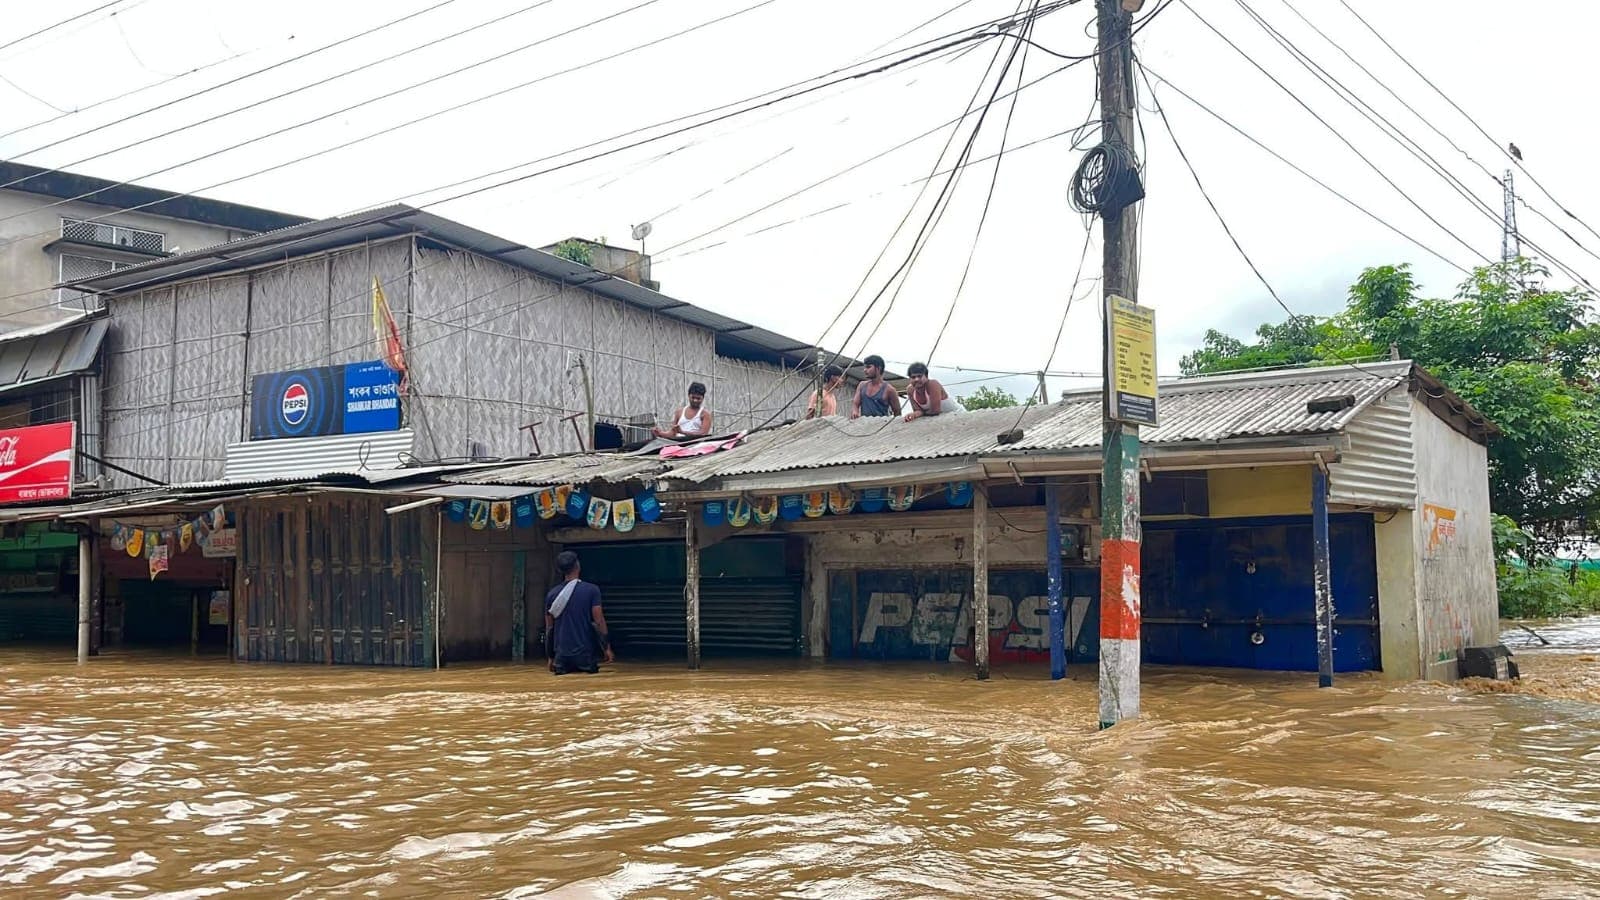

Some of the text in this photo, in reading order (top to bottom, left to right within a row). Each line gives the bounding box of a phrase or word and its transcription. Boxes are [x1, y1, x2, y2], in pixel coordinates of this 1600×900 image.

[284, 399, 307, 409] PEPSI
[347, 398, 396, 412] SHANKAR BHANDAR
[858, 592, 1091, 650] PEPSI
